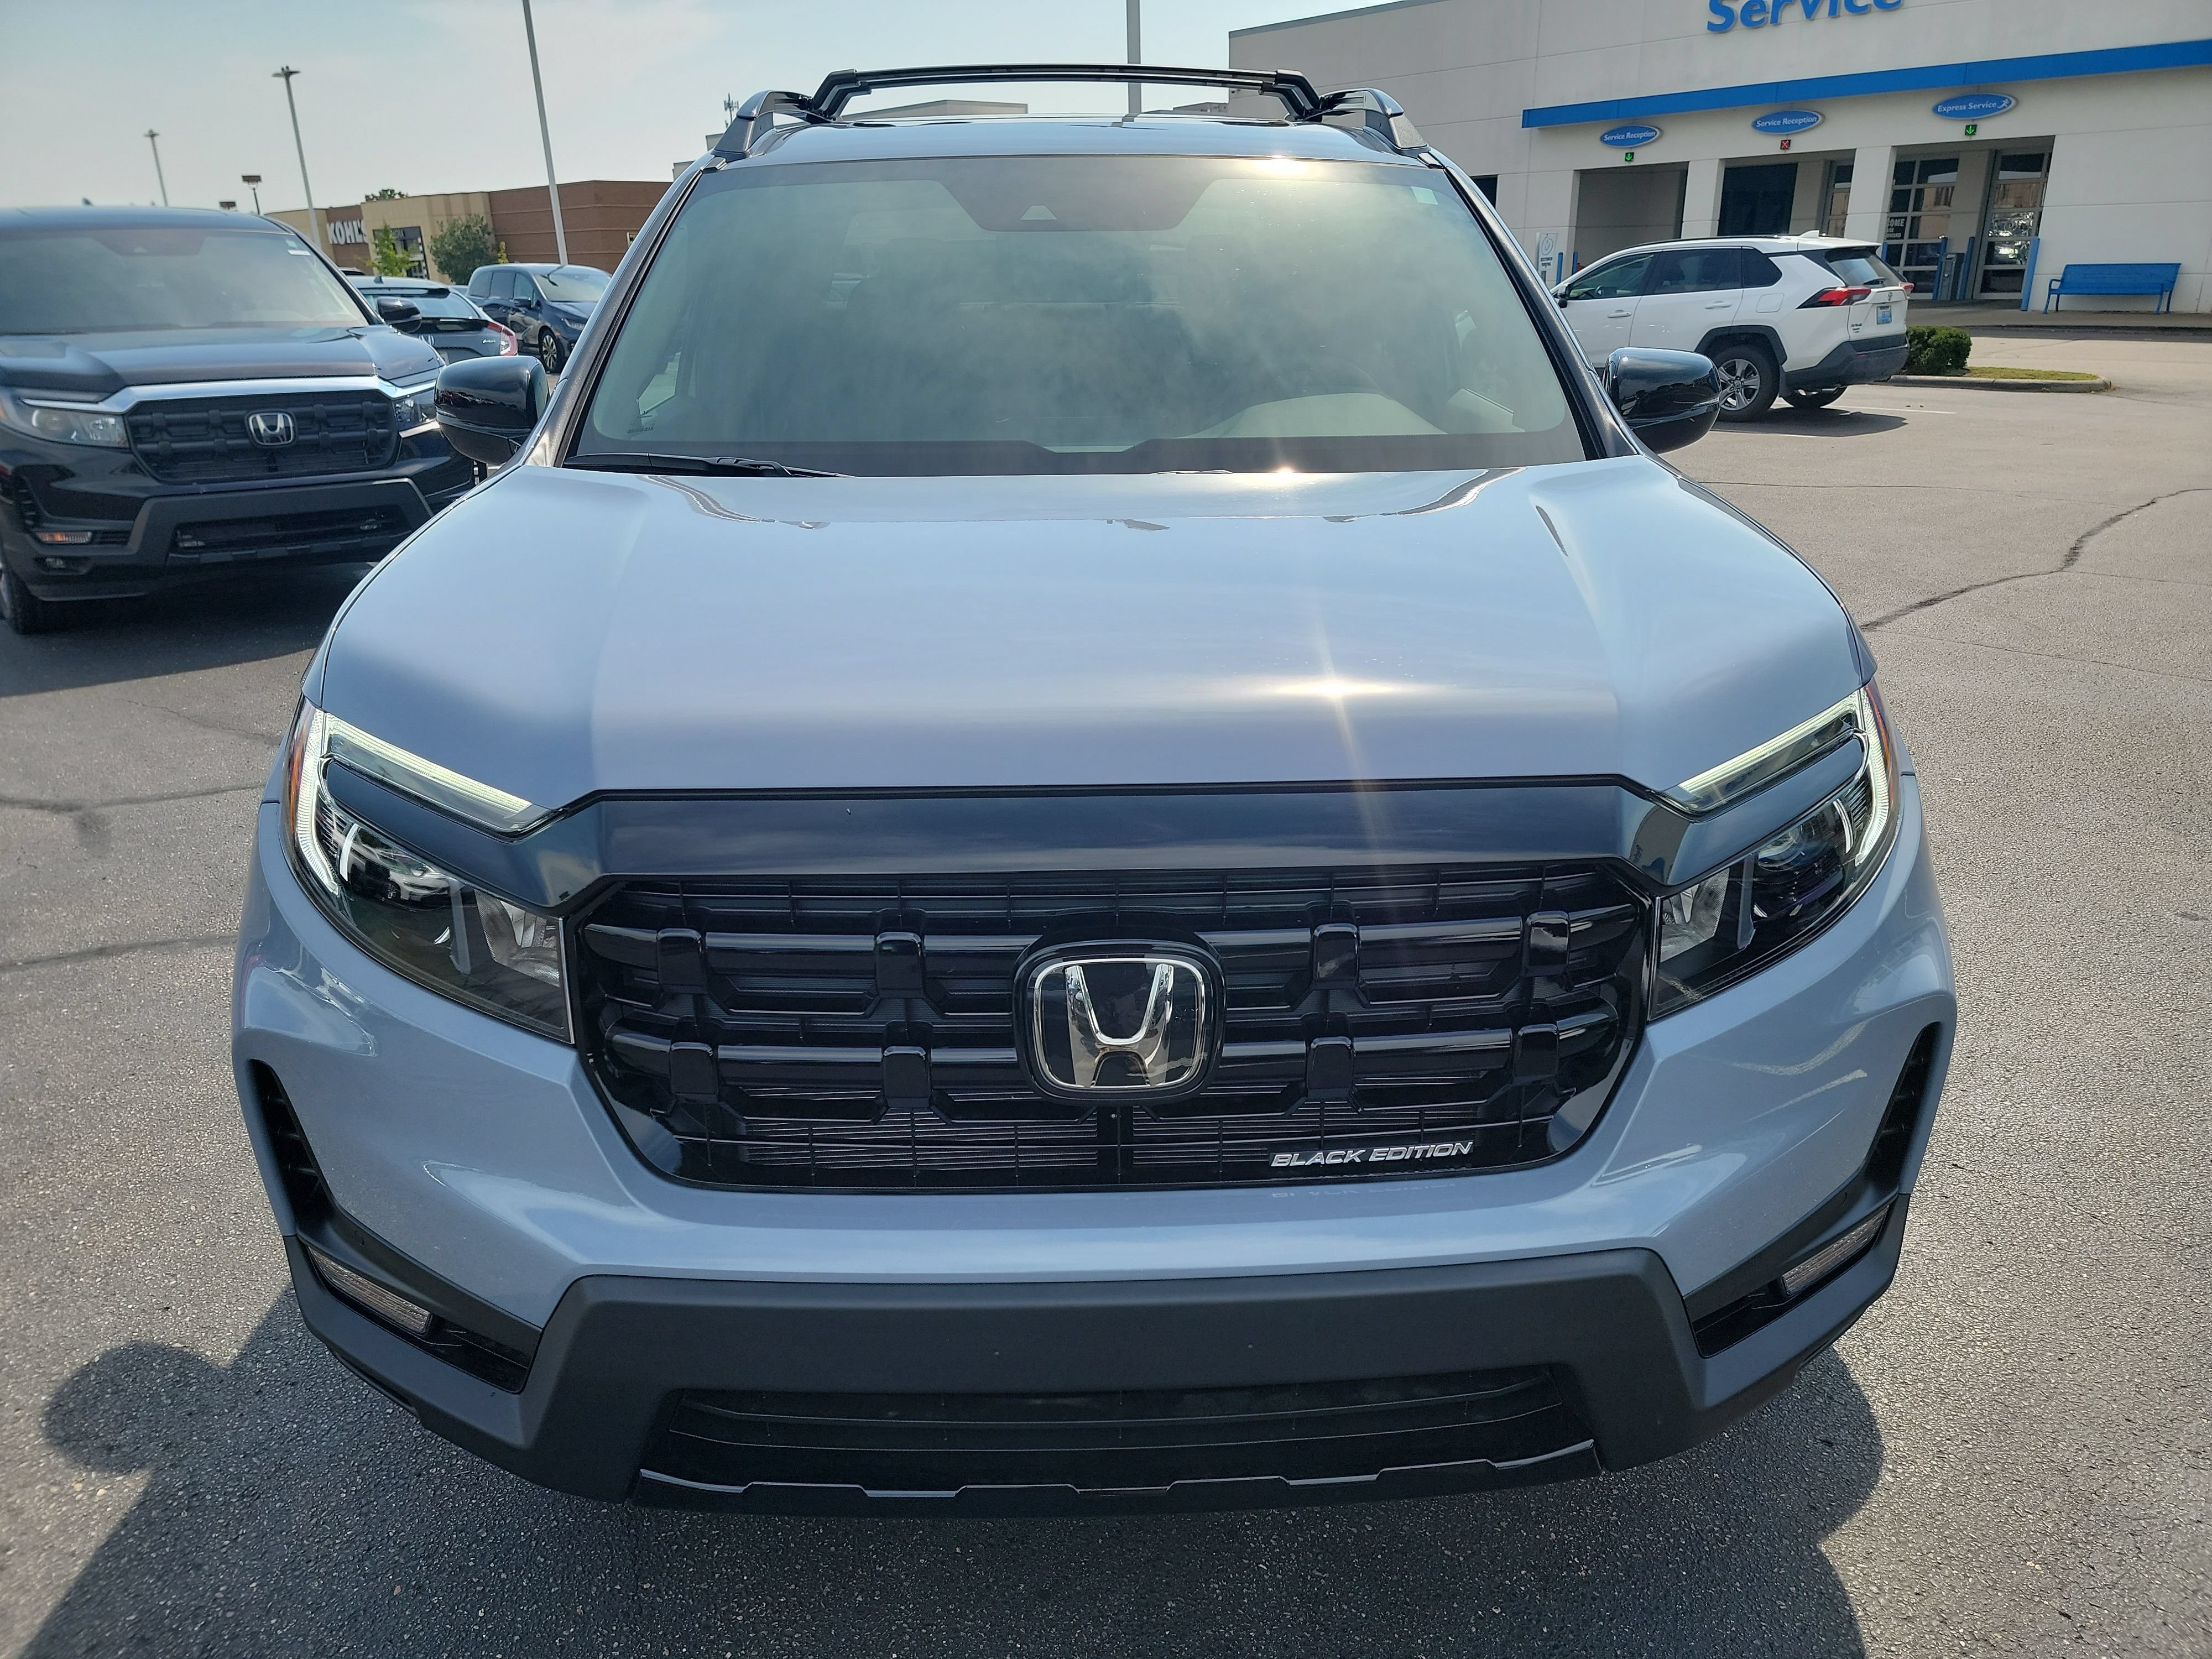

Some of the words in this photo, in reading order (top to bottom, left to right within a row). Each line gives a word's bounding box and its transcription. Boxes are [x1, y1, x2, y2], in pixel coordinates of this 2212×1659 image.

[1782, 116, 1817, 125] Reception
[1271, 1150, 1366, 1167] BLACK
[1369, 1141, 1473, 1161] EDITION
